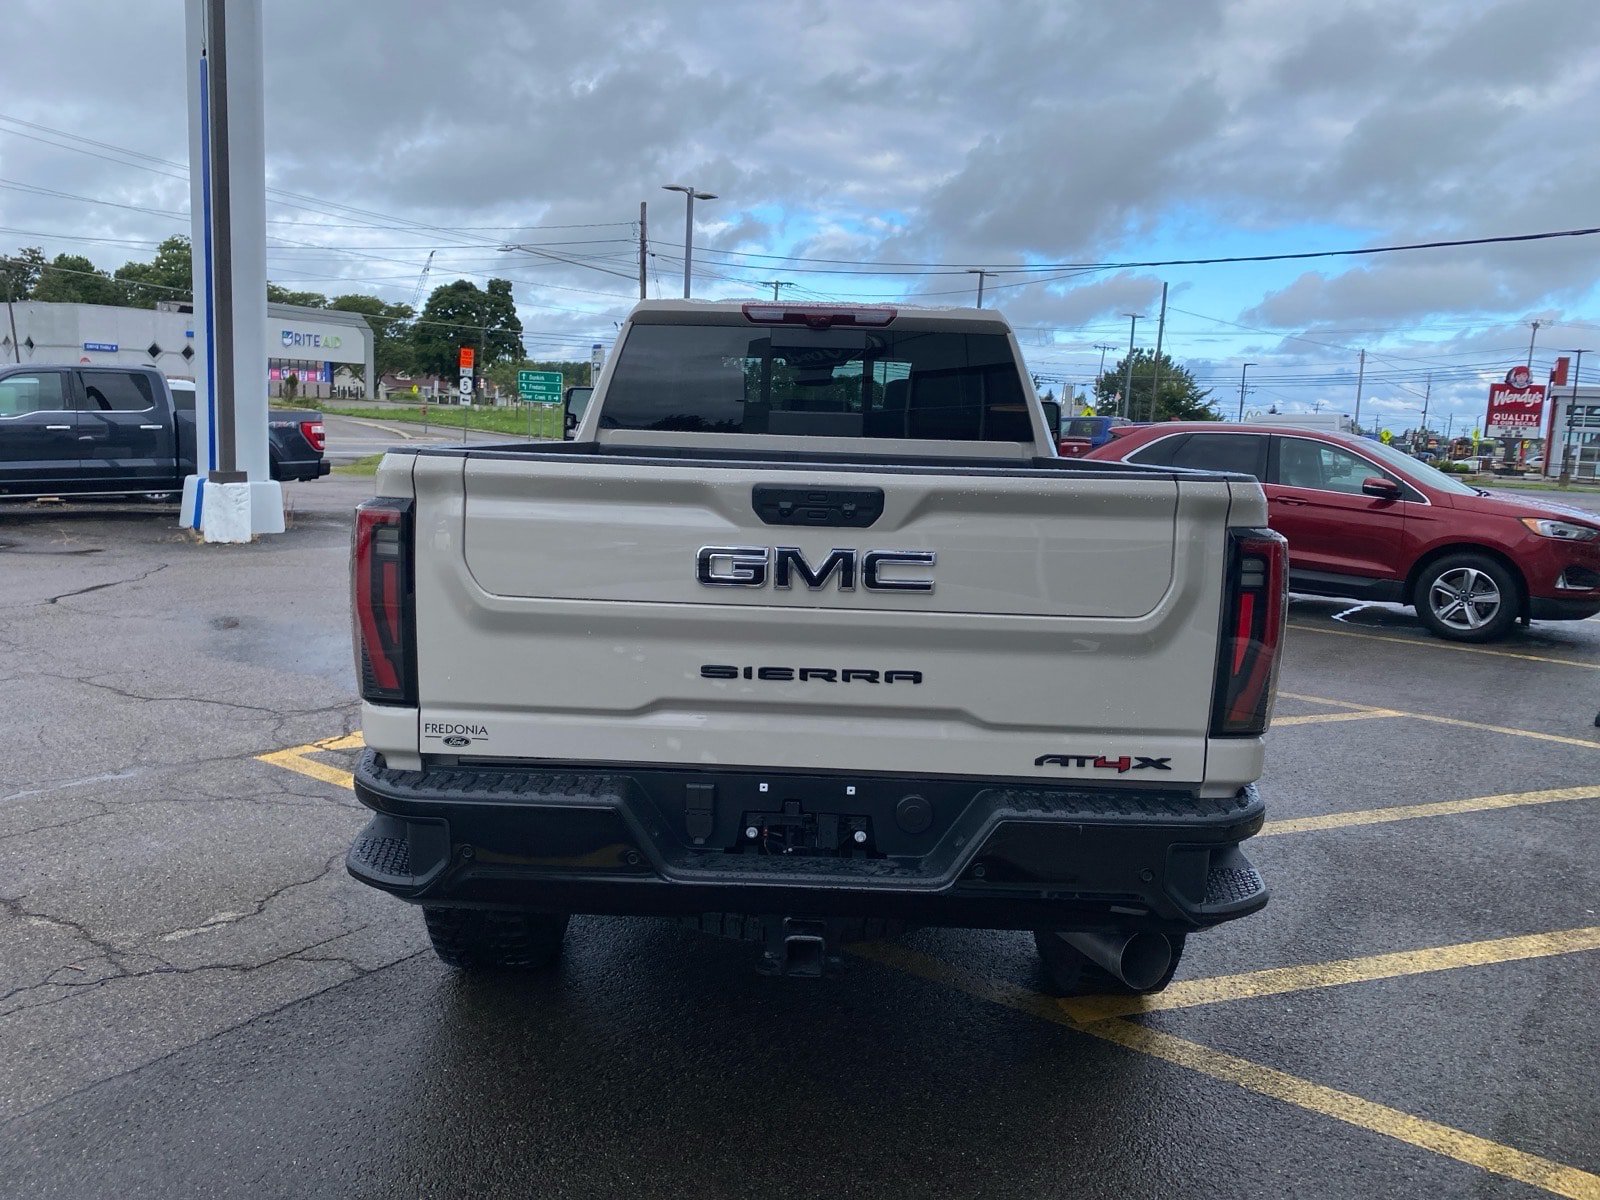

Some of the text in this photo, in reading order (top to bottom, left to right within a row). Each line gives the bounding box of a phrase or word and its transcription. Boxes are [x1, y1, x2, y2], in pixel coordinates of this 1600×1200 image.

[294, 332, 342, 349] RITE AID
[463, 381, 469, 391] 5
[1493, 388, 1543, 407] Wendy's
[1493, 412, 1539, 422] QUALITY
[696, 545, 936, 595] GMC
[700, 664, 923, 684] SIERRA
[424, 723, 489, 736] FREDONIA
[448, 738, 466, 746] Ford
[1034, 753, 1172, 774] AT4X
